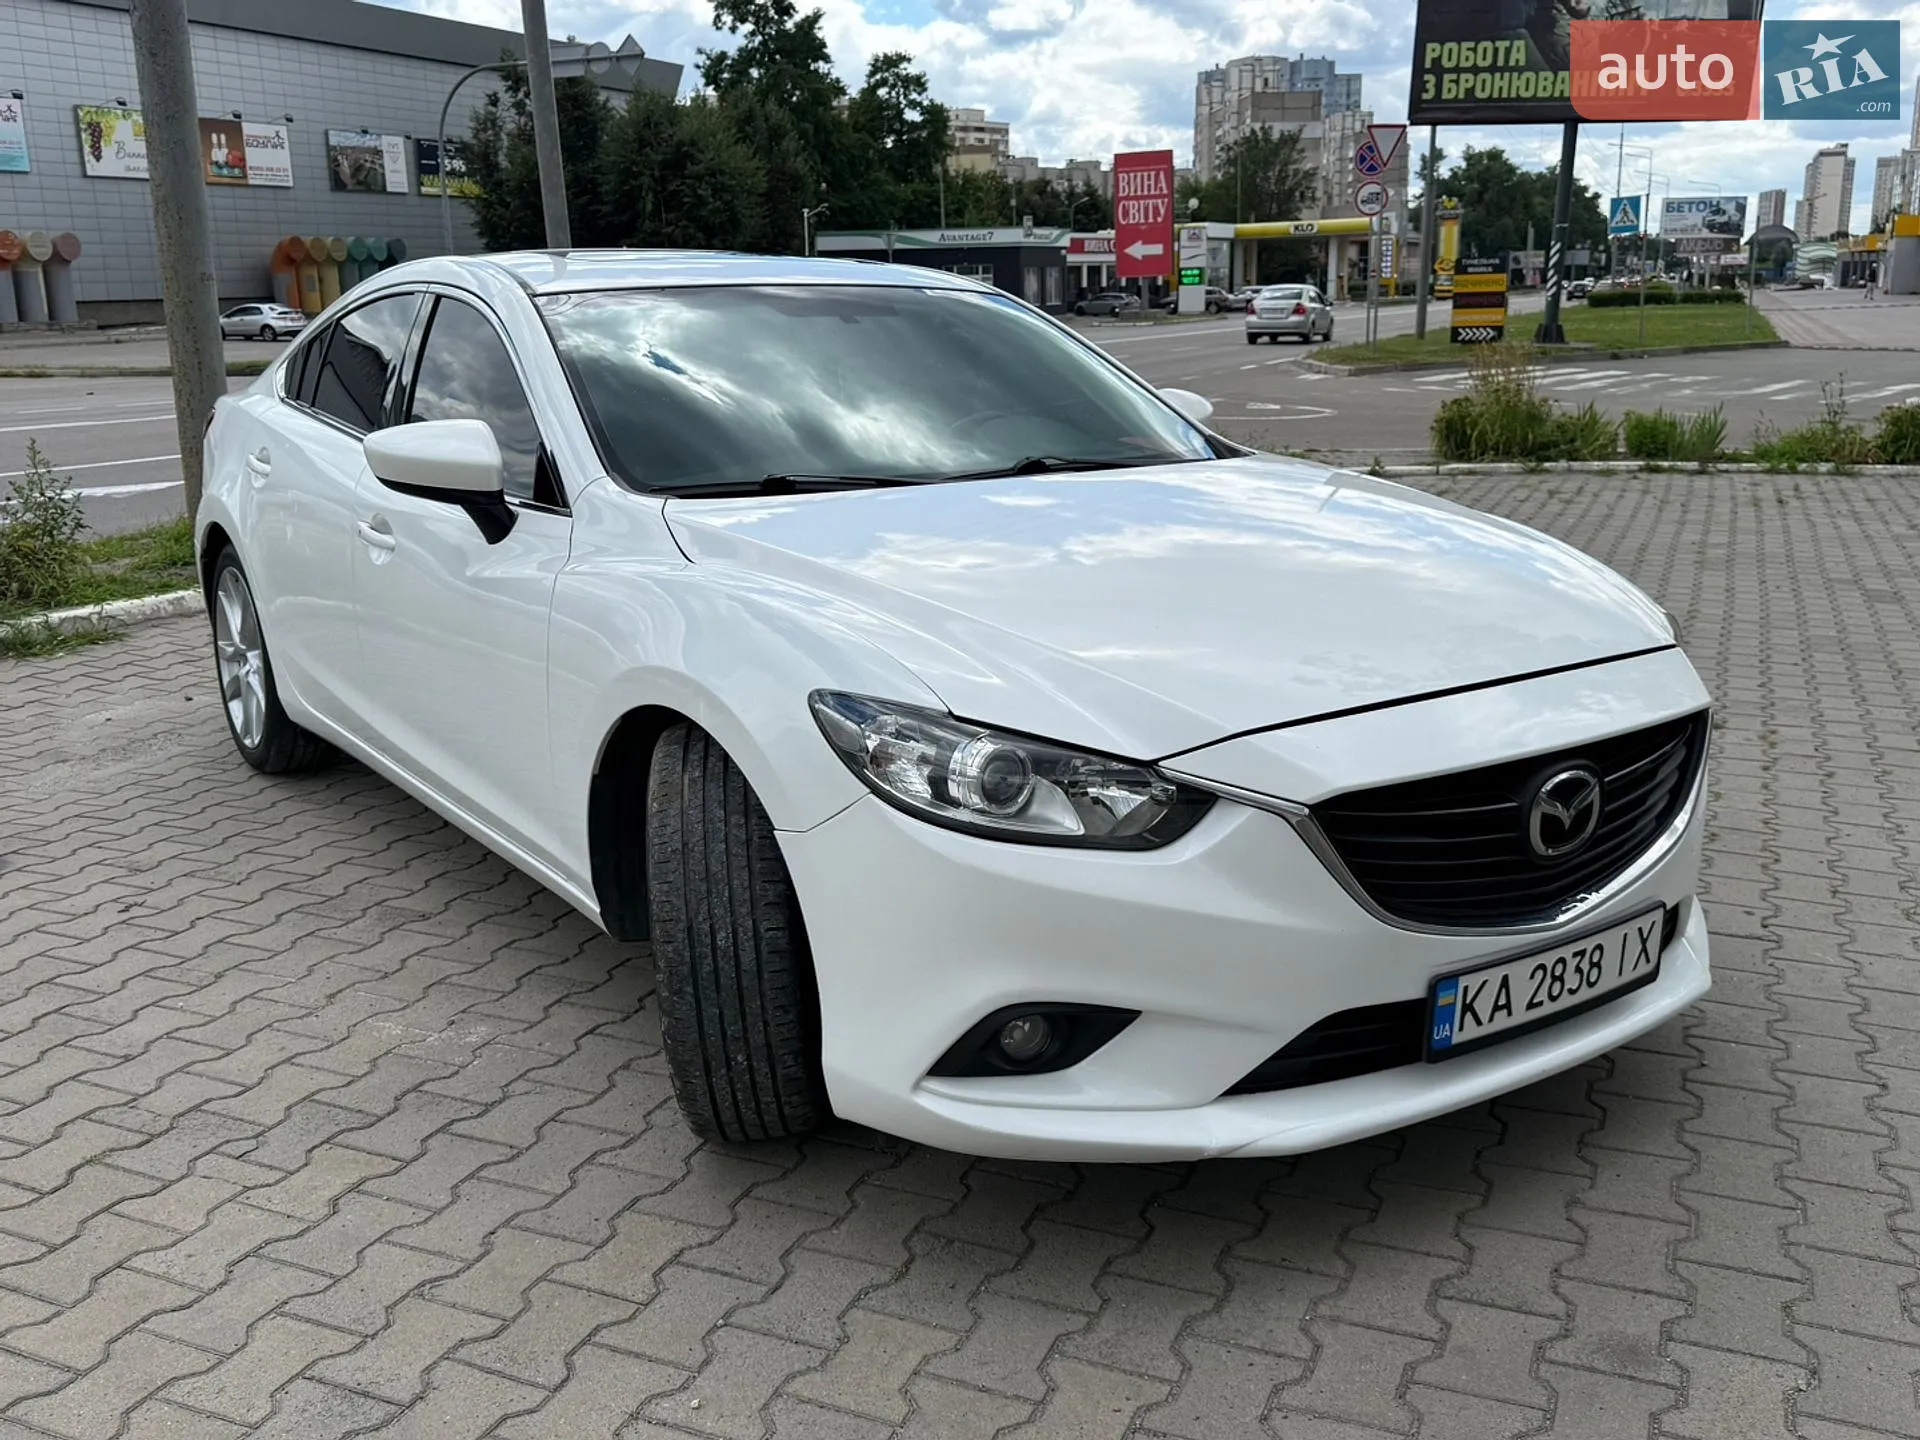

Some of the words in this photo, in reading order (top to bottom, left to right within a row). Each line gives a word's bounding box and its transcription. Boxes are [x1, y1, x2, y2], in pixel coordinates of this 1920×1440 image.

[1424, 40, 1526, 69] РОБОТА
[1421, 73, 1436, 100] З
[1117, 170, 1169, 197] ВИНА
[1117, 198, 1169, 225] СВІТУ
[1665, 200, 1720, 213] БЕТОН
[1293, 223, 1315, 233] KLO
[1458, 974, 1512, 1032] KA
[1525, 943, 1604, 1012] 2838
[1618, 920, 1657, 977] IX
[1433, 1025, 1452, 1041] UA
